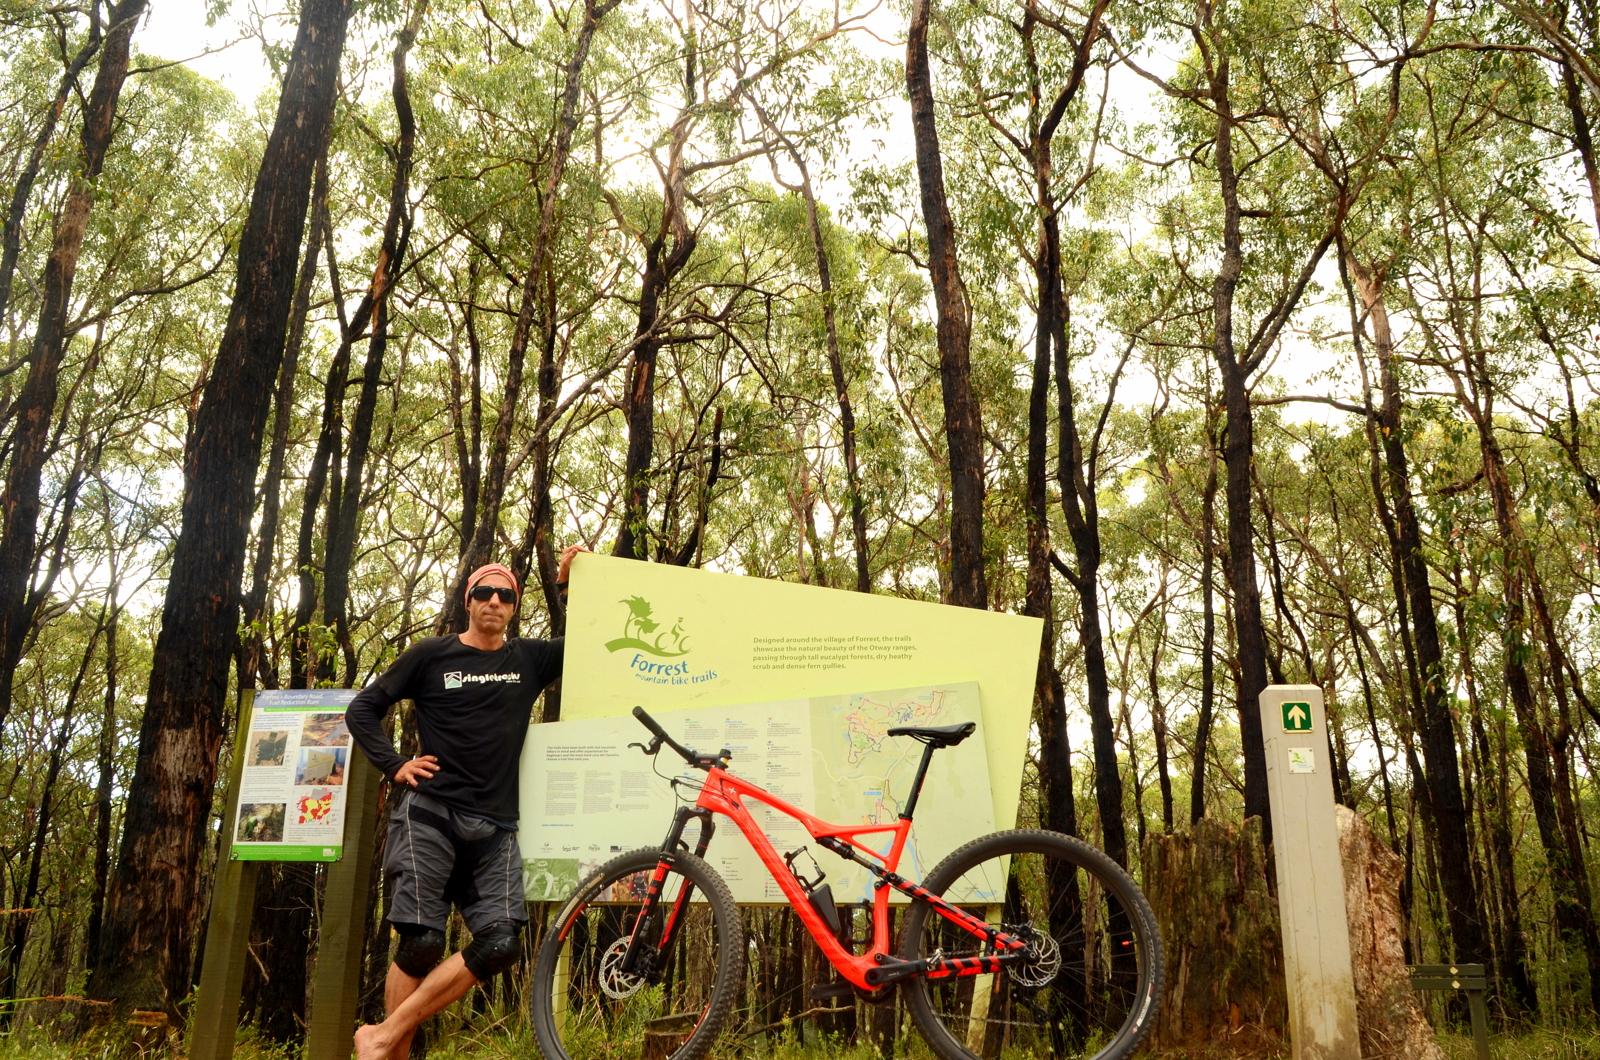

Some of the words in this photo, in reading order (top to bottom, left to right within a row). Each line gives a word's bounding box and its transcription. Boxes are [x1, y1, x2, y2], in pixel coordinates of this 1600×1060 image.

[824, 636, 846, 644] village
[869, 644, 892, 652] Otway
[752, 654, 778, 662] passing
[630, 653, 689, 676] Forrest
[635, 673, 668, 684] mountain
[671, 677, 689, 685] bike
[691, 670, 718, 684] trails
